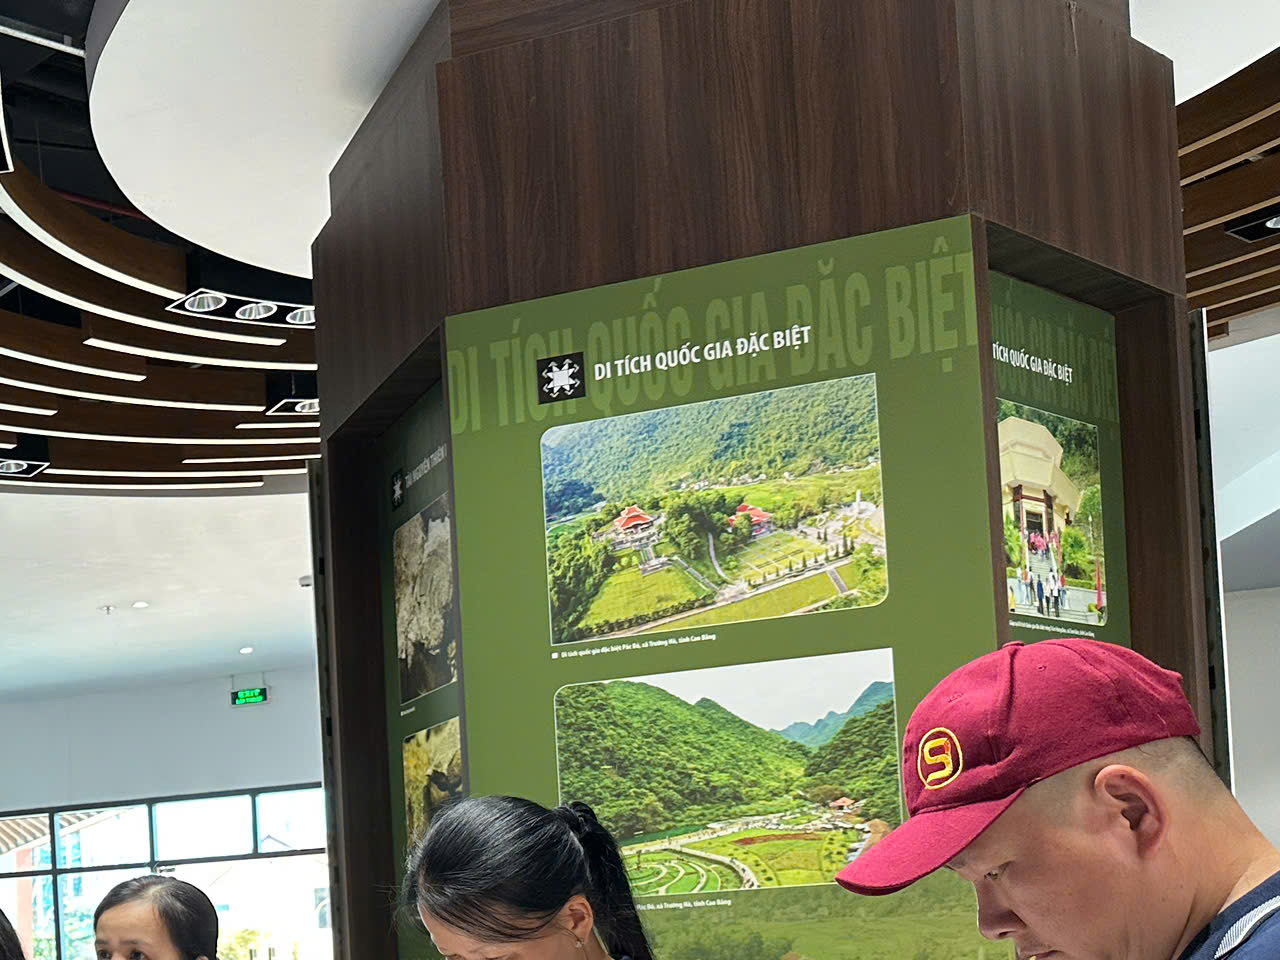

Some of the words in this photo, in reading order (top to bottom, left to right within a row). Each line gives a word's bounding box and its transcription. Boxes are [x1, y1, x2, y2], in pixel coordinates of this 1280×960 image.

[594, 362, 611, 380] DI
[614, 352, 651, 377] TÍCH
[655, 342, 700, 370] QUỐC
[704, 340, 732, 361] GIA
[736, 332, 770, 357] ĐẶC
[773, 325, 811, 350] BIỆT
[705, 292, 776, 390] GIA
[992, 341, 1008, 363] TÍCH
[1010, 348, 1029, 370] QUỐC
[1030, 356, 1043, 373] GIA
[1044, 358, 1057, 381] ĐẶC
[1058, 364, 1072, 386] BIỆT
